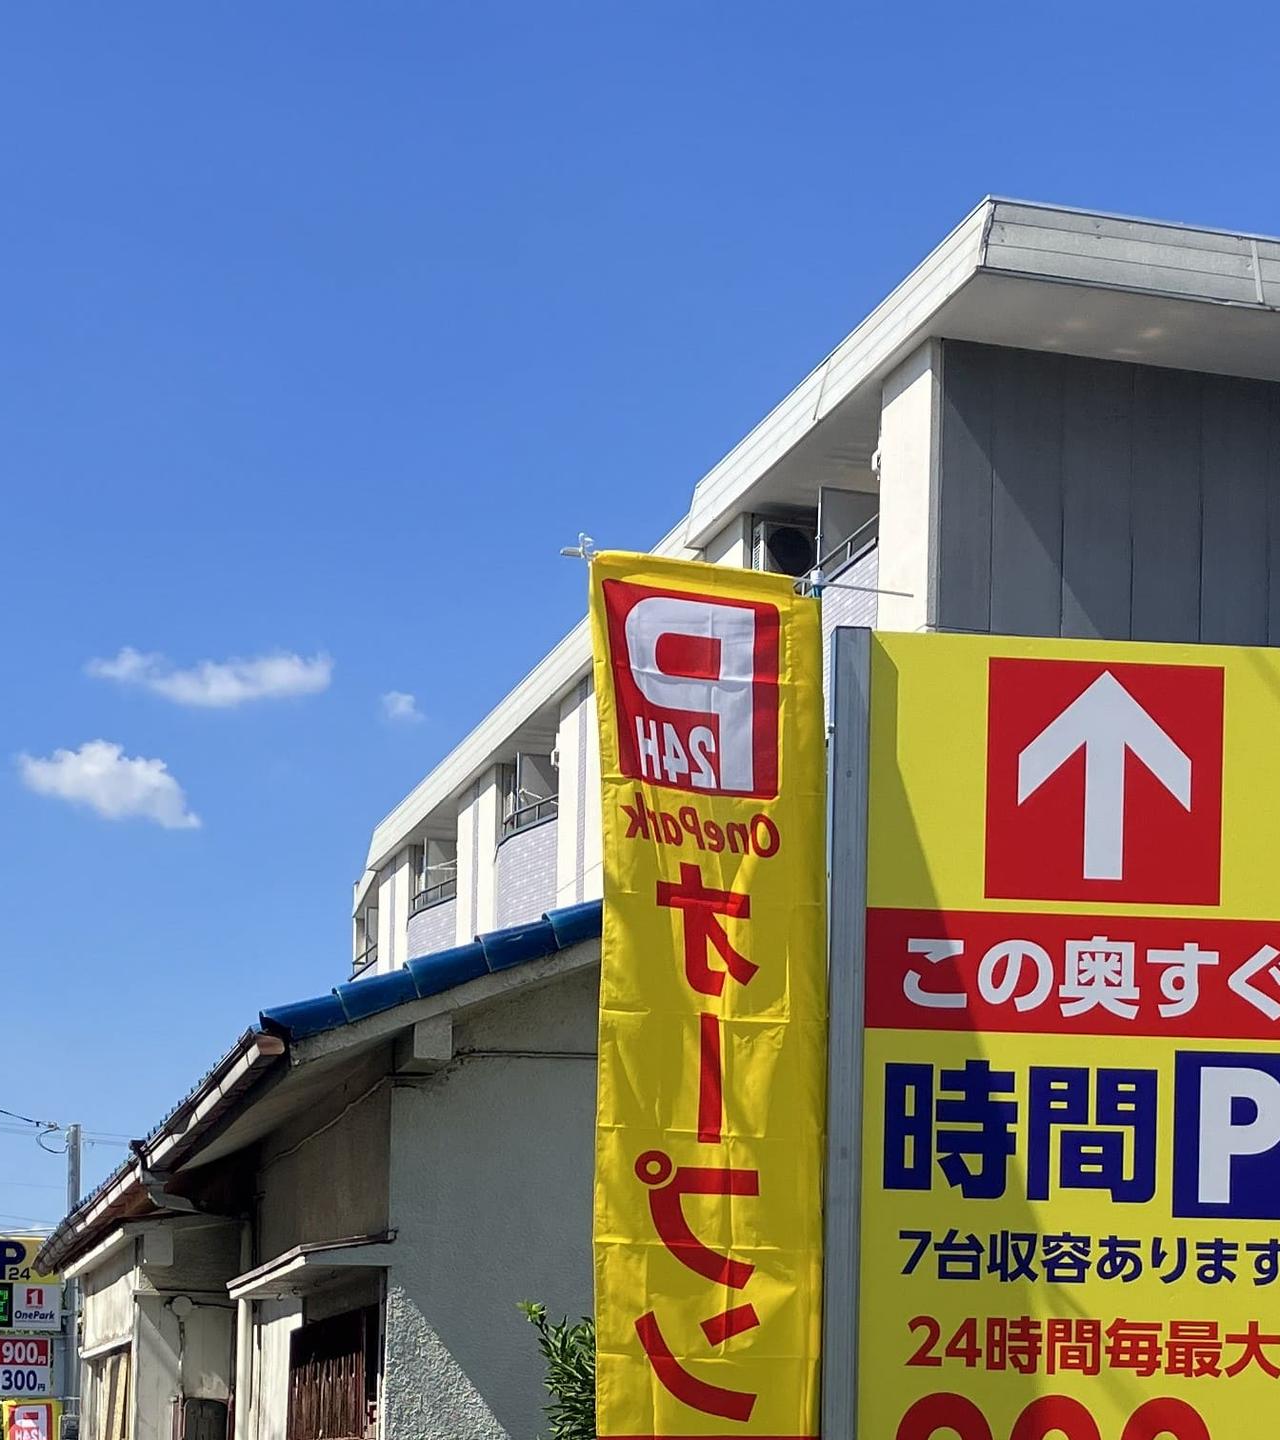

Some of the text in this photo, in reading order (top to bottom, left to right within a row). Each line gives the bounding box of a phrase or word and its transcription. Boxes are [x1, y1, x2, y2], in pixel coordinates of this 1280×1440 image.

[883, 1059, 1158, 1204] 時間
[8, 1267, 31, 1280] 24
[14, 1310, 56, 1321] OnePark
[1, 1341, 46, 1365] 900円
[1, 1369, 45, 1391] 300円
